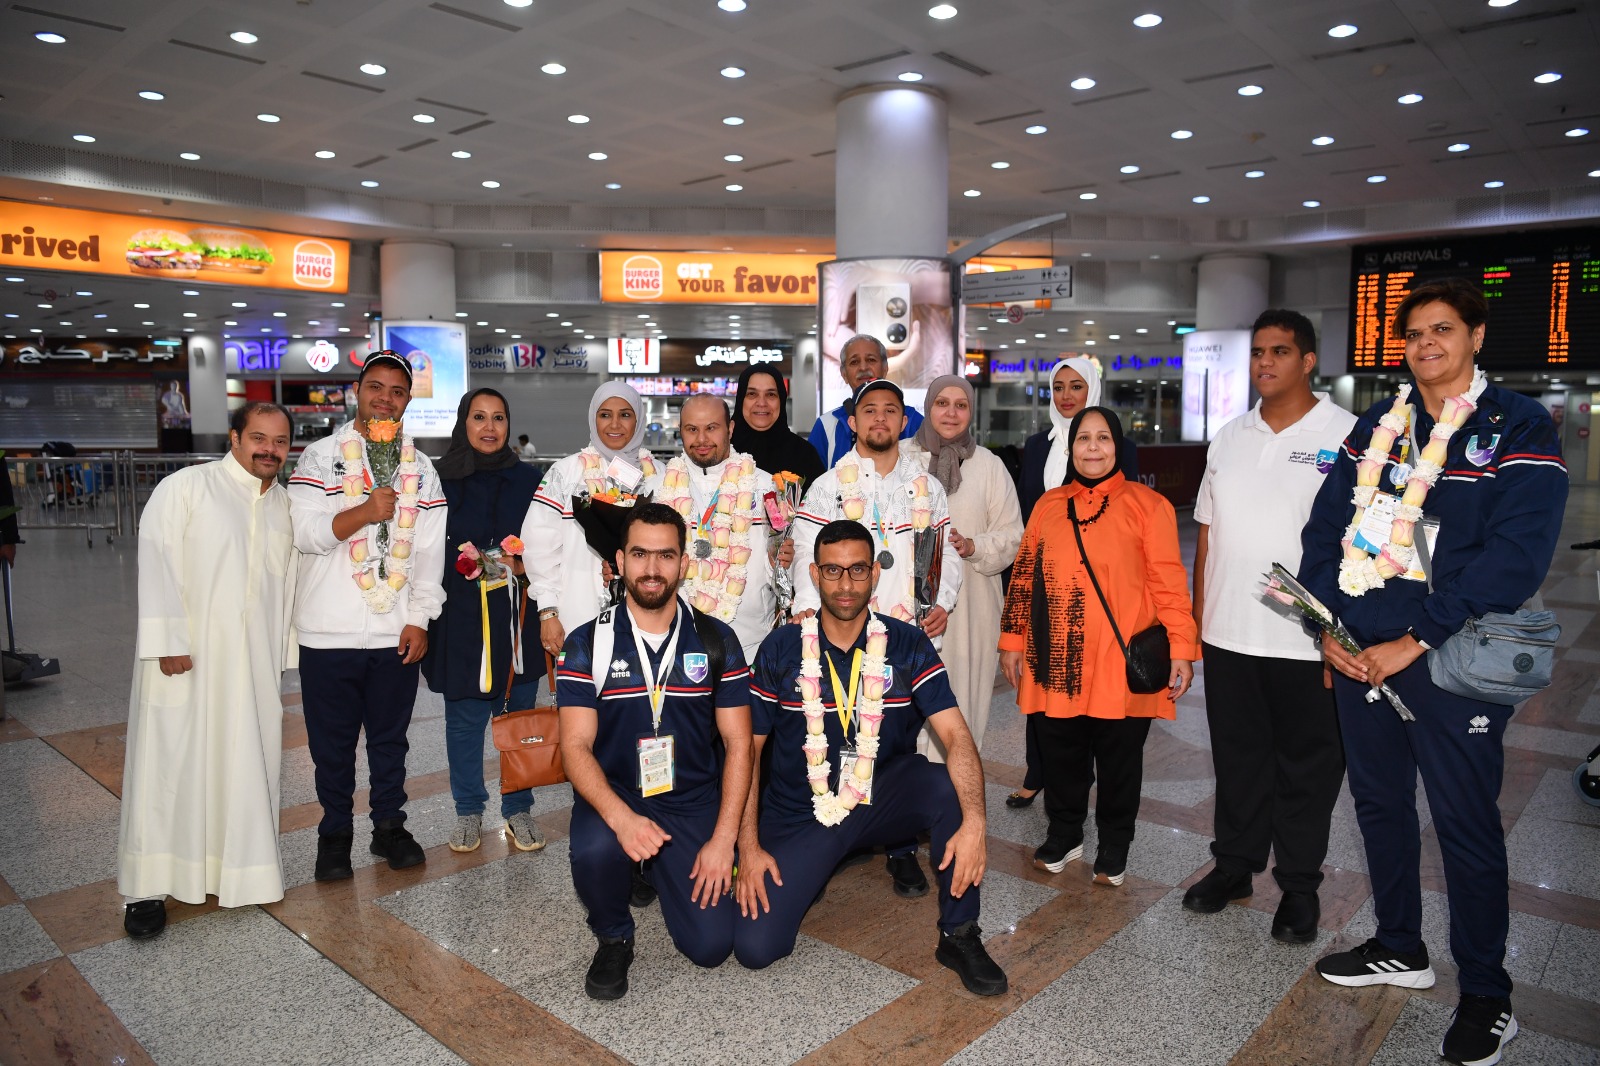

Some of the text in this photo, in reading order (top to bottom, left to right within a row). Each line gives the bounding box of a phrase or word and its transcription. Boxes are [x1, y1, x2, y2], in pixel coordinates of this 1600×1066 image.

[1, 226, 100, 262] rived
[296, 254, 332, 265] BURGER
[1382, 247, 1452, 264] ARRIVALS
[296, 264, 332, 278] KING
[625, 270, 660, 278] BURGER
[677, 262, 713, 279] GET
[625, 278, 660, 289] KING
[678, 279, 725, 293] YOUR
[734, 266, 816, 294] favor
[695, 345, 748, 366] كنتاكي
[1189, 344, 1222, 353] HUAWEI
[469, 358, 506, 370] obbins
[990, 358, 1025, 374] Food
